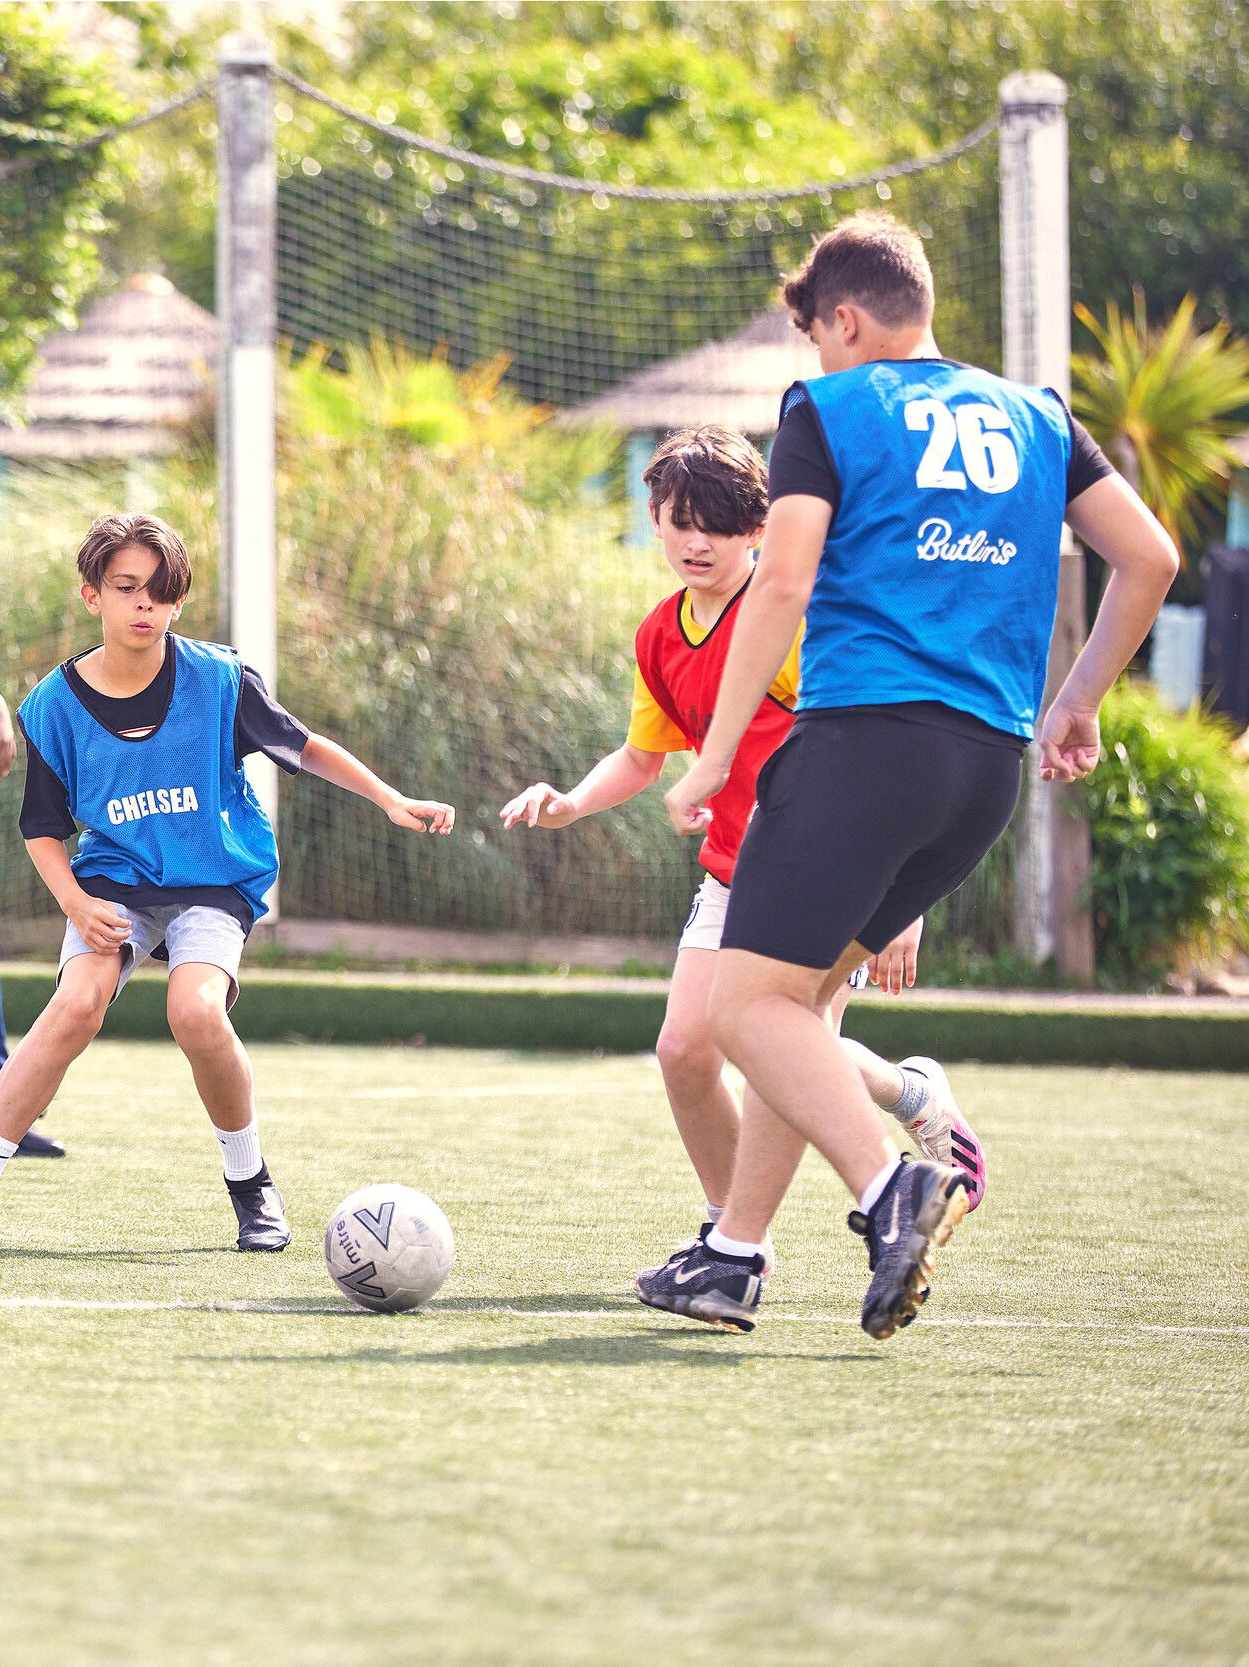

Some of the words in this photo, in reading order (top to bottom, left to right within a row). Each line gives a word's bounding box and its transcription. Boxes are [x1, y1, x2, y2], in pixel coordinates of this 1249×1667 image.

[904, 398, 1019, 494] 26
[917, 517, 1017, 566] Butlin's
[107, 786, 199, 825] CHELSEA
[337, 1220, 361, 1265] mitre
